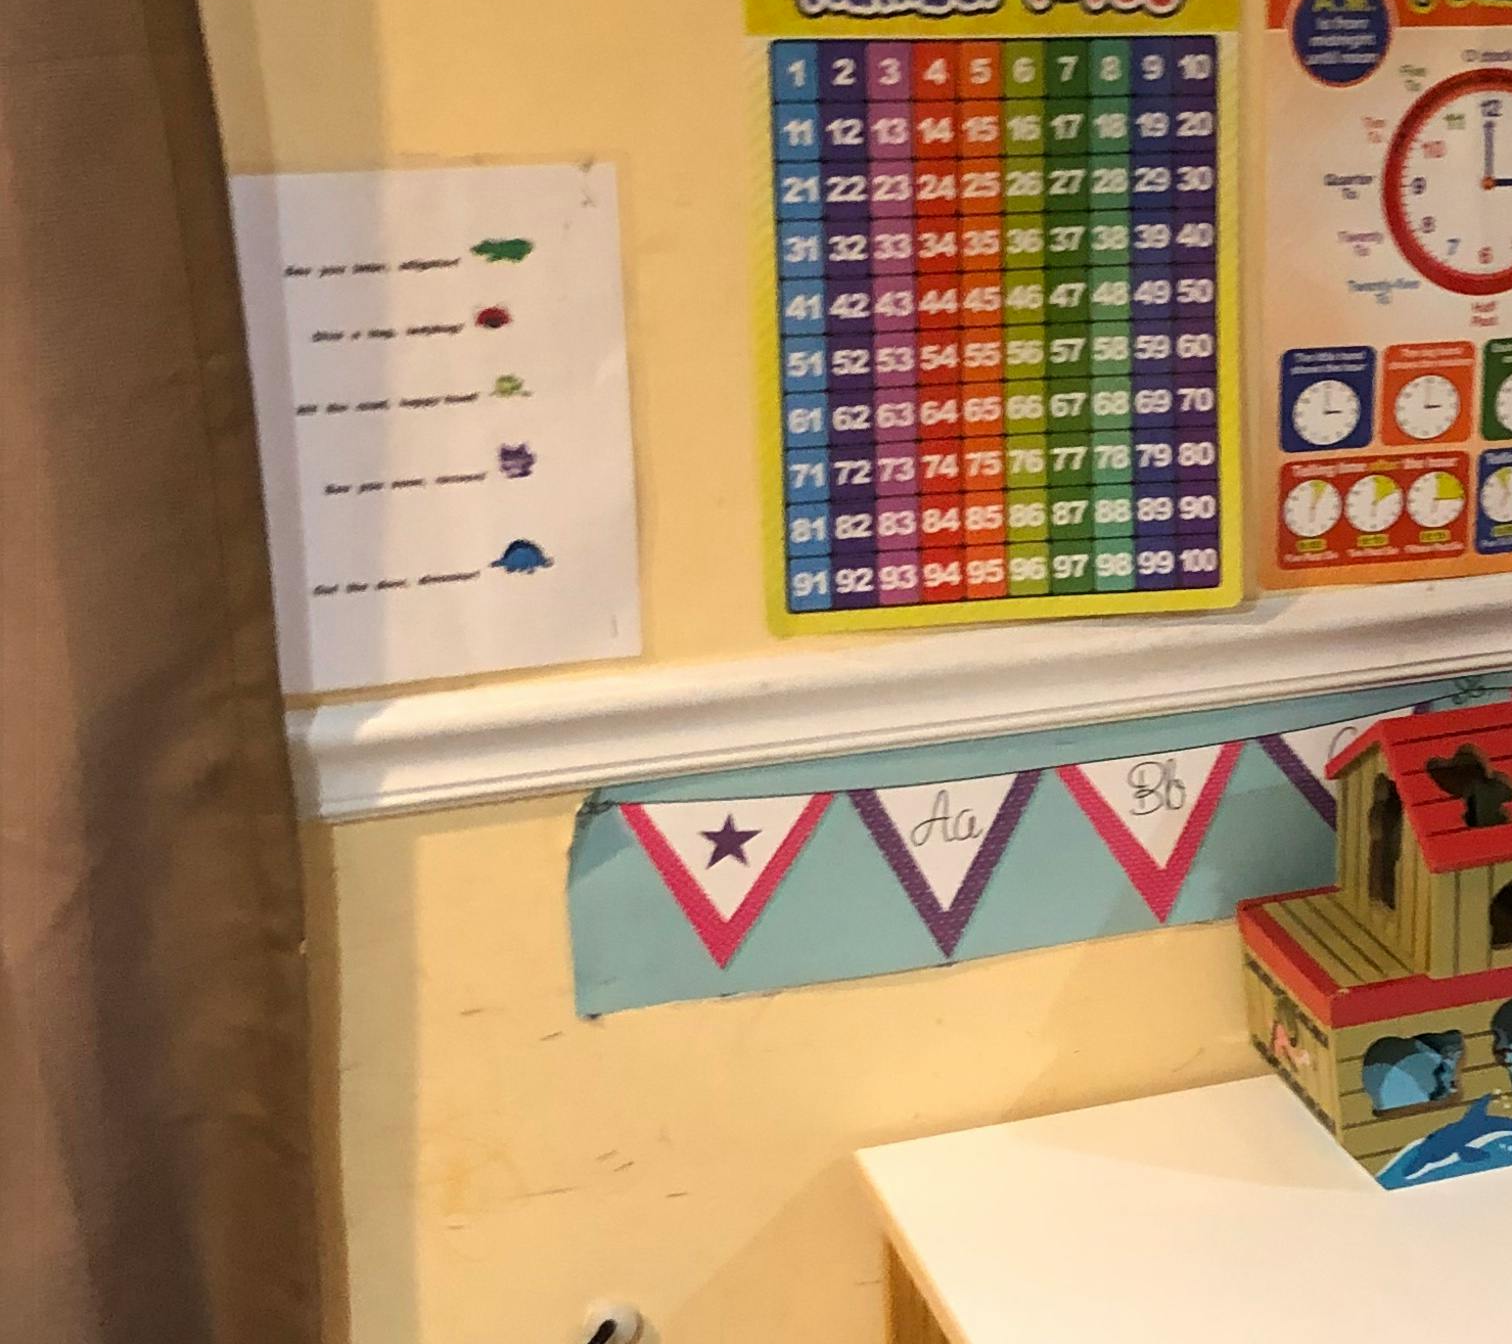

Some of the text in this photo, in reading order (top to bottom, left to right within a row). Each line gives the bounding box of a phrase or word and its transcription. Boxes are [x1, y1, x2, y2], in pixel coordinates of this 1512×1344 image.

[788, 388, 1213, 434] 61 62 63 64 65 66 67 68 69 70
[789, 442, 1214, 488] 71 72 73 74 75 76 77 78 79 80
[790, 495, 1215, 543] 81 82 83 84 85 86 87 88 89 90
[793, 548, 1216, 596] 91 92 93 94 95 96 97 98 99 100
[1127, 759, 1187, 817] Bb
[911, 790, 984, 847] Aa
